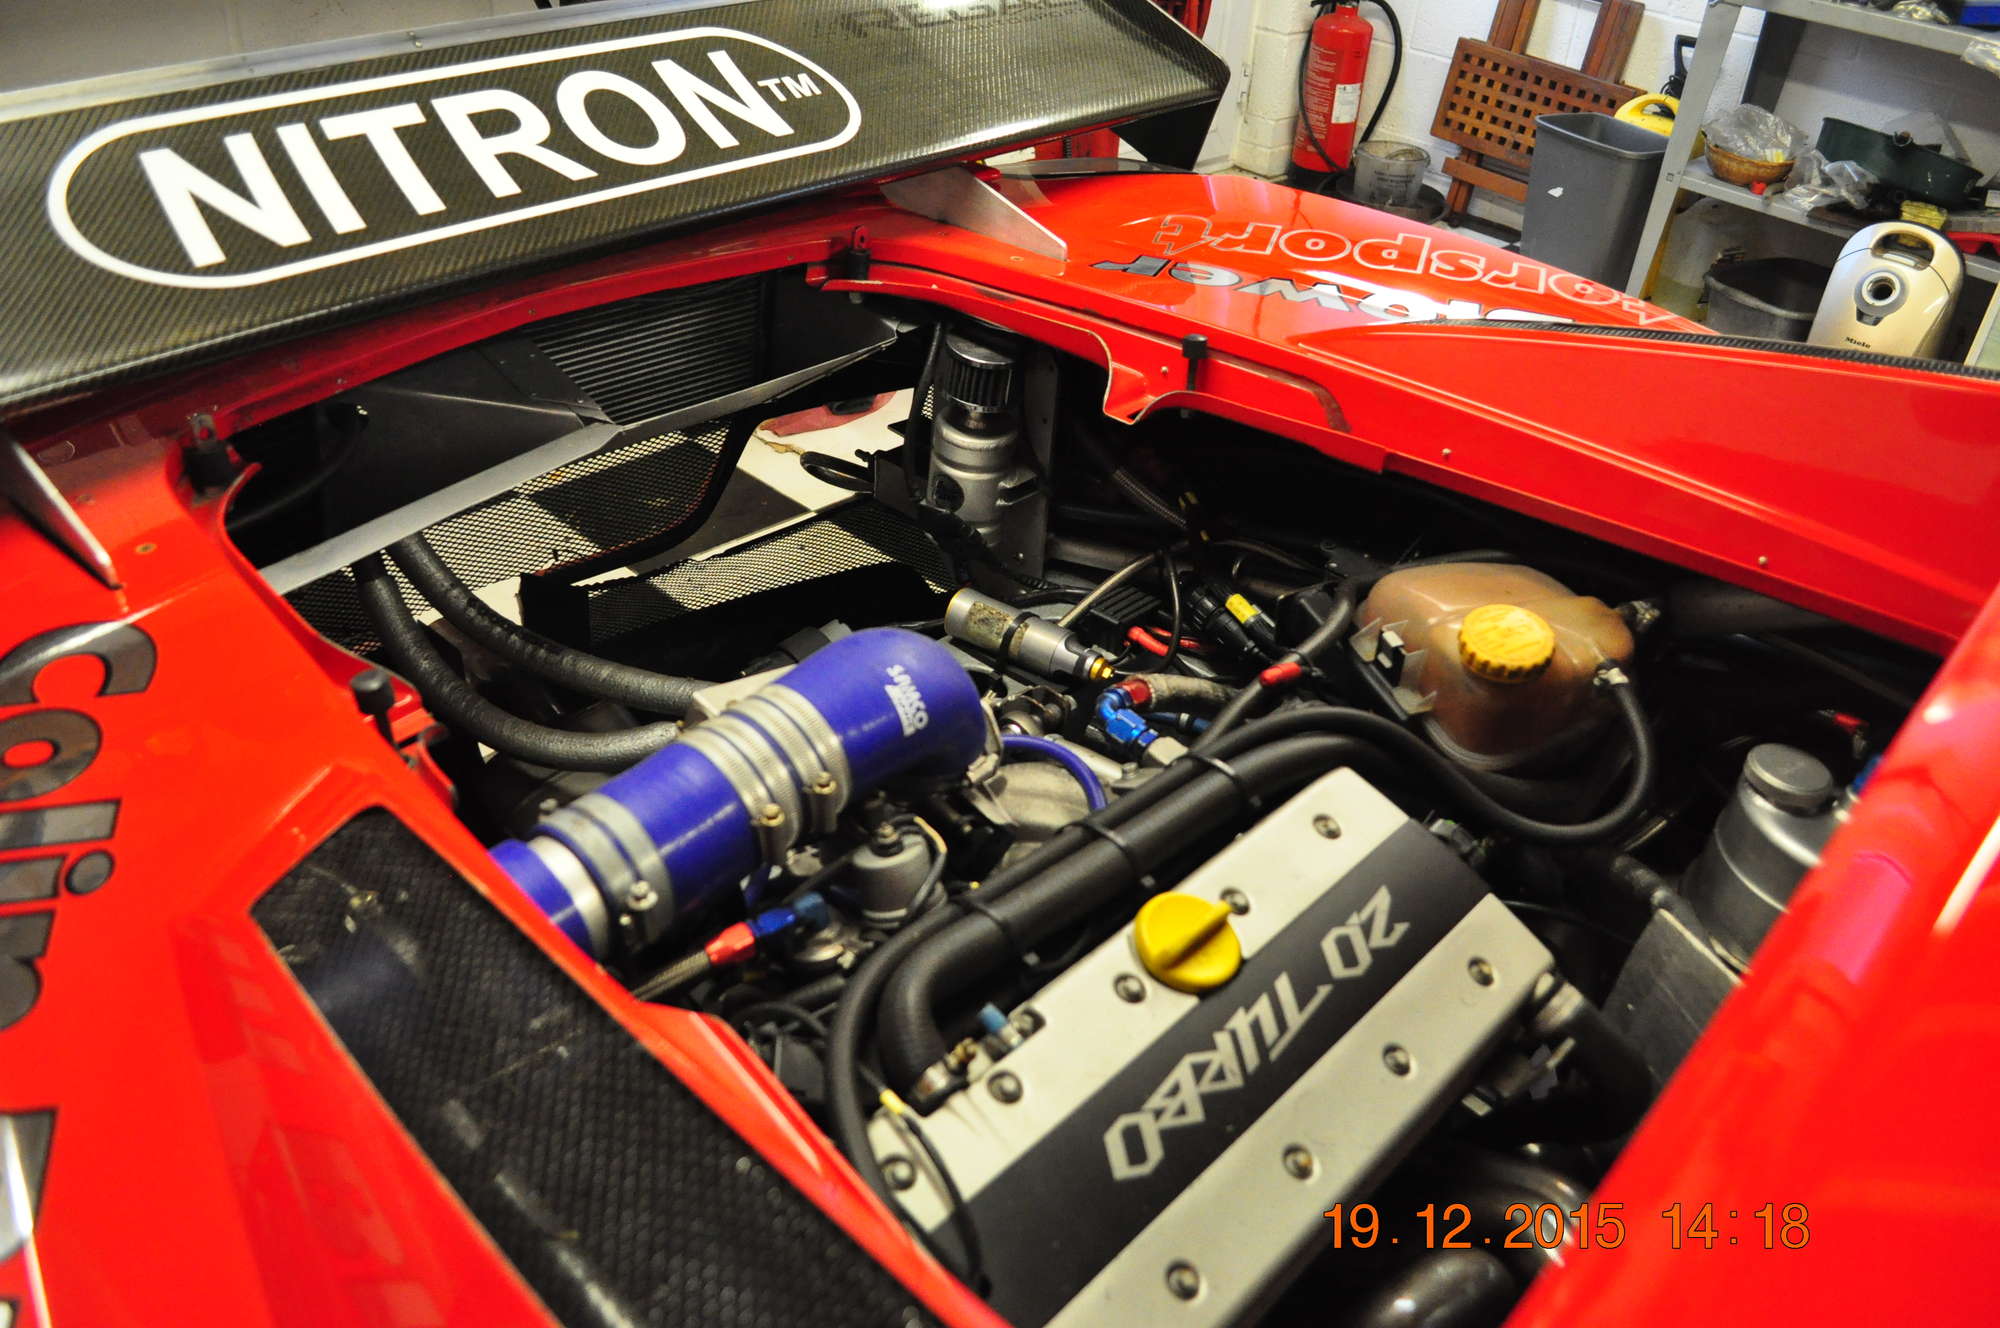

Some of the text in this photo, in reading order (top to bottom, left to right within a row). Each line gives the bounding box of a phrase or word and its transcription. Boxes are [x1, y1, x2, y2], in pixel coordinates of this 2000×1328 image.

[138, 49, 796, 268] NITRON
[1843, 336, 1872, 350] Miele
[1103, 971, 1334, 1181] TURBO
